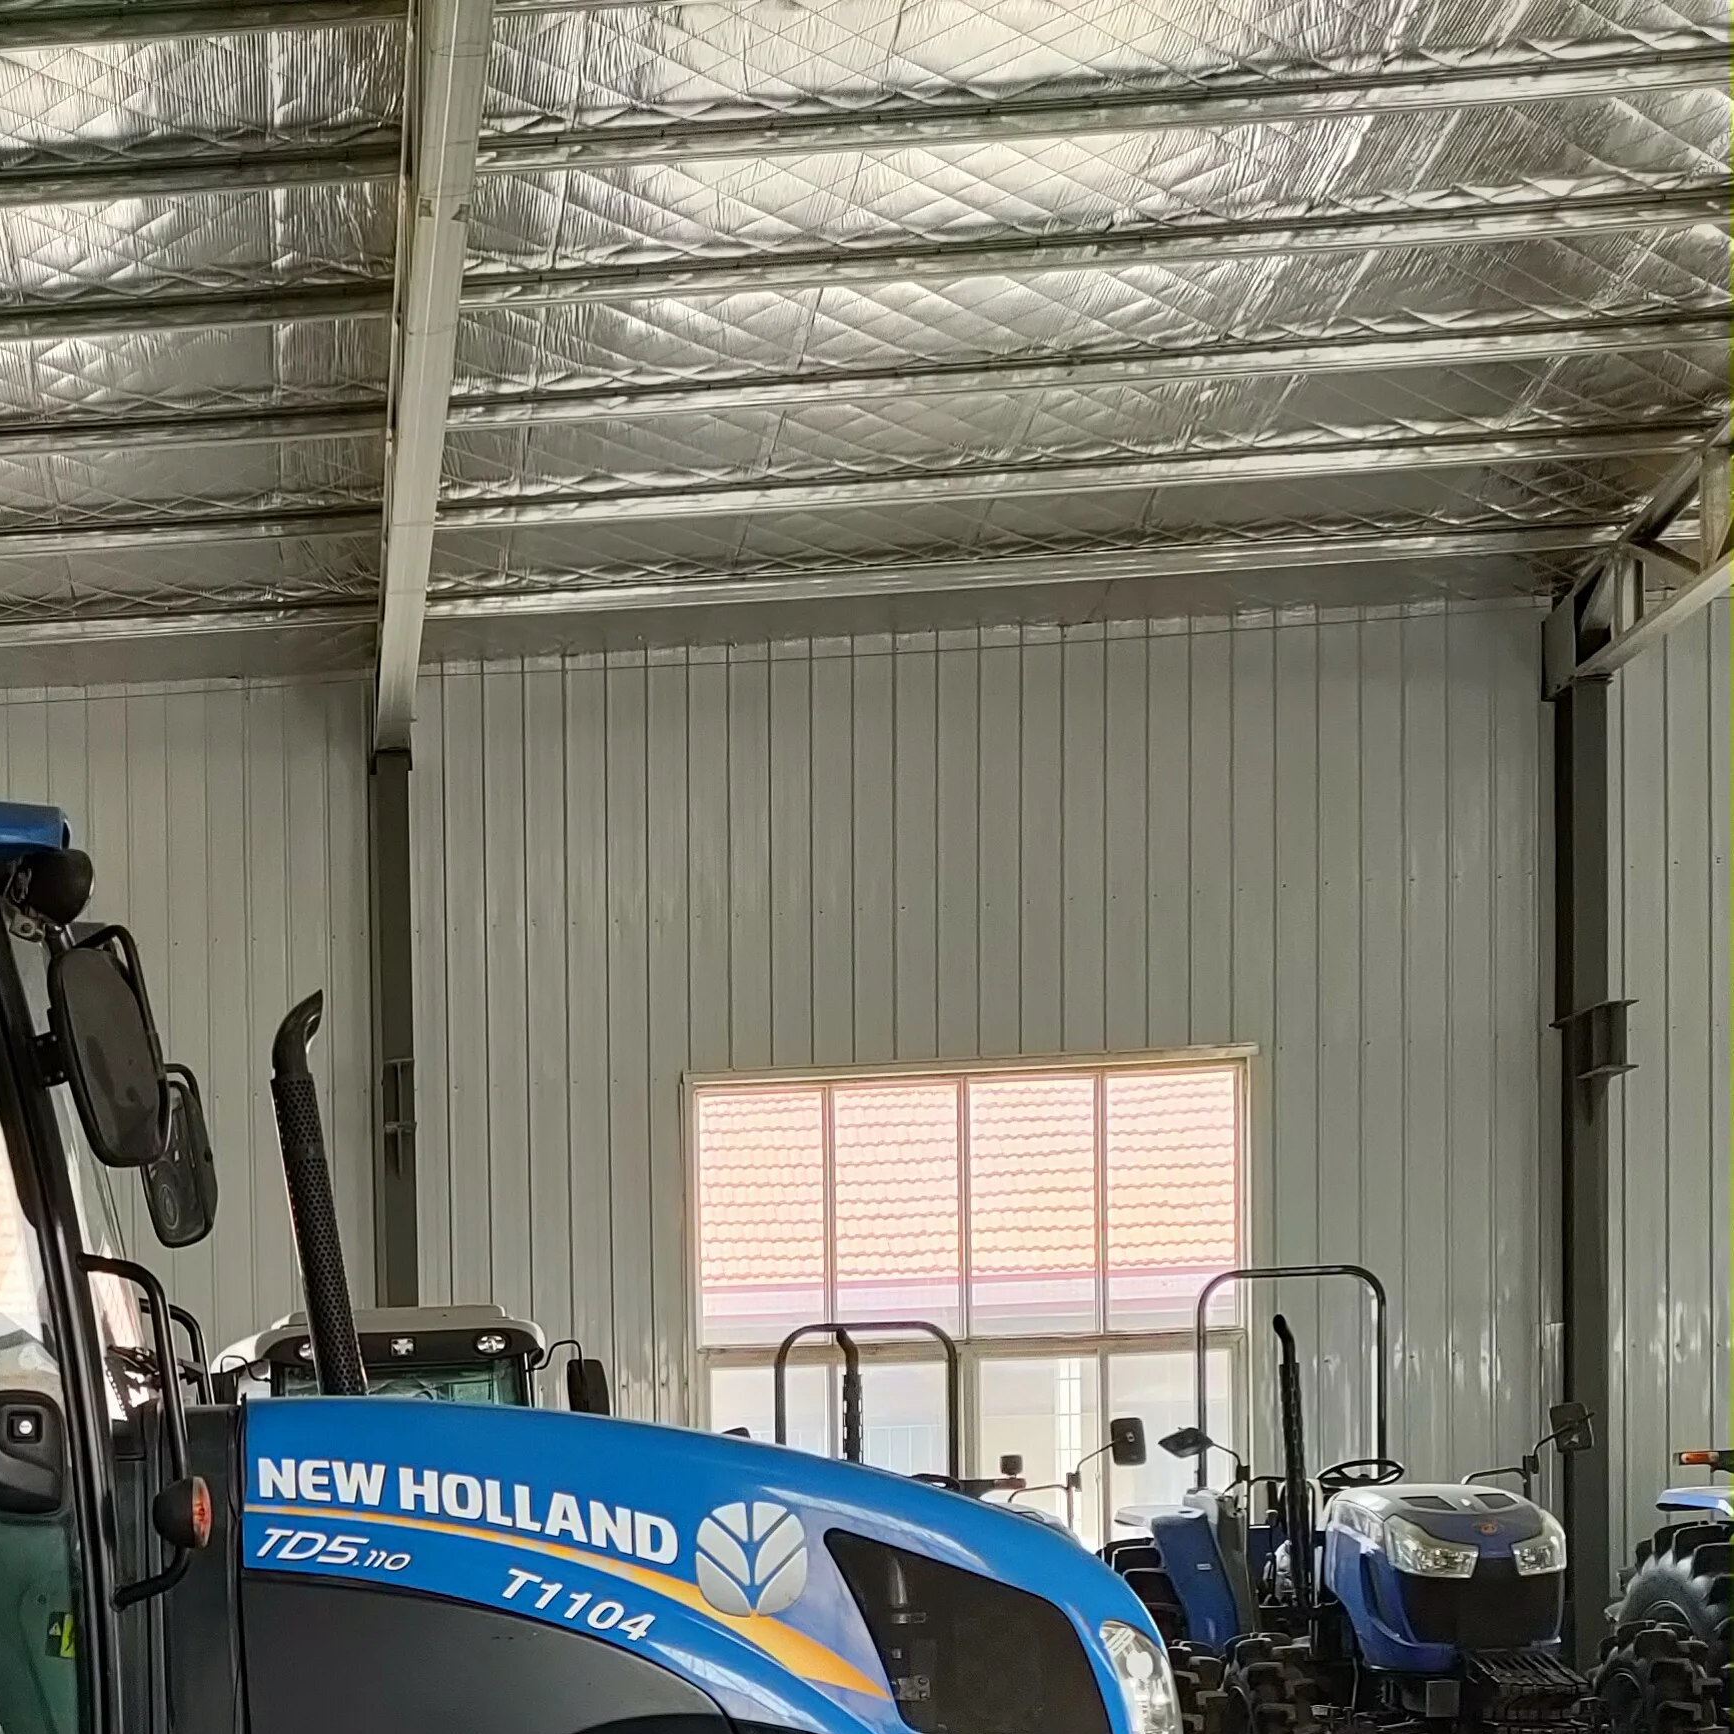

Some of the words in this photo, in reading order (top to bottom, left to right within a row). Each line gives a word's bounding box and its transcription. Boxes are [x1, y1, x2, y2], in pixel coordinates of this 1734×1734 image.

[258, 1457, 386, 1507] NEW
[398, 1466, 679, 1565] HOLLAND
[501, 1568, 657, 1641] T1104
